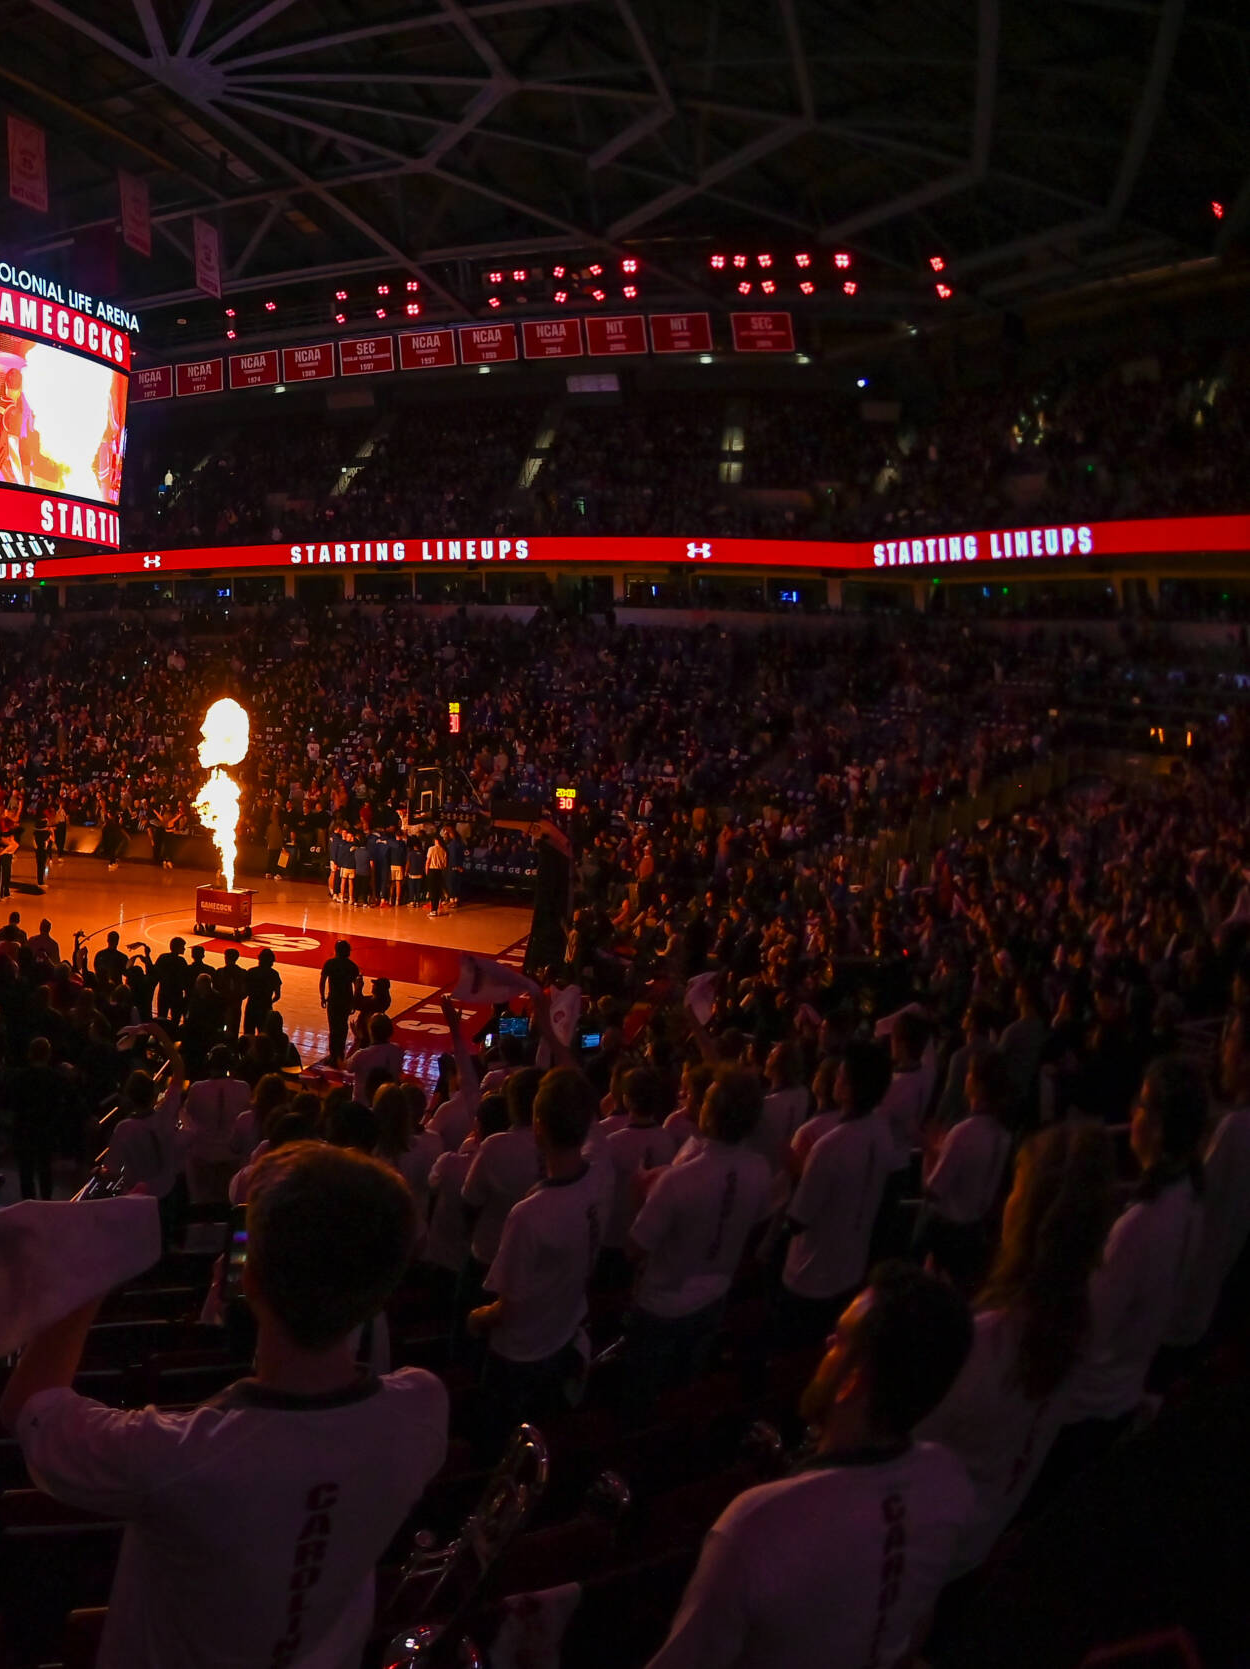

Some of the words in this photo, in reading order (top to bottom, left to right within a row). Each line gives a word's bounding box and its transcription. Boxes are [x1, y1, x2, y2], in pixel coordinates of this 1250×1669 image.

[69, 288, 93, 312] LIFE
[96, 300, 140, 333] ARENA
[536, 323, 566, 338] NCAA
[750, 316, 773, 330] SEC
[411, 334, 441, 350] NCAA
[472, 329, 502, 343] NCAA
[294, 348, 321, 363] NCAA
[356, 341, 375, 355] SEC
[240, 355, 266, 370] NCAA
[138, 370, 162, 384] NCAA
[187, 363, 212, 378] NCAA
[290, 541, 405, 564] STARTING
[421, 540, 529, 561] LINEUPS
[873, 535, 978, 567] STARTING
[989, 526, 1094, 560] LINEUPS
[559, 797, 573, 809] 30
[200, 900, 233, 913] GAMECOCK
